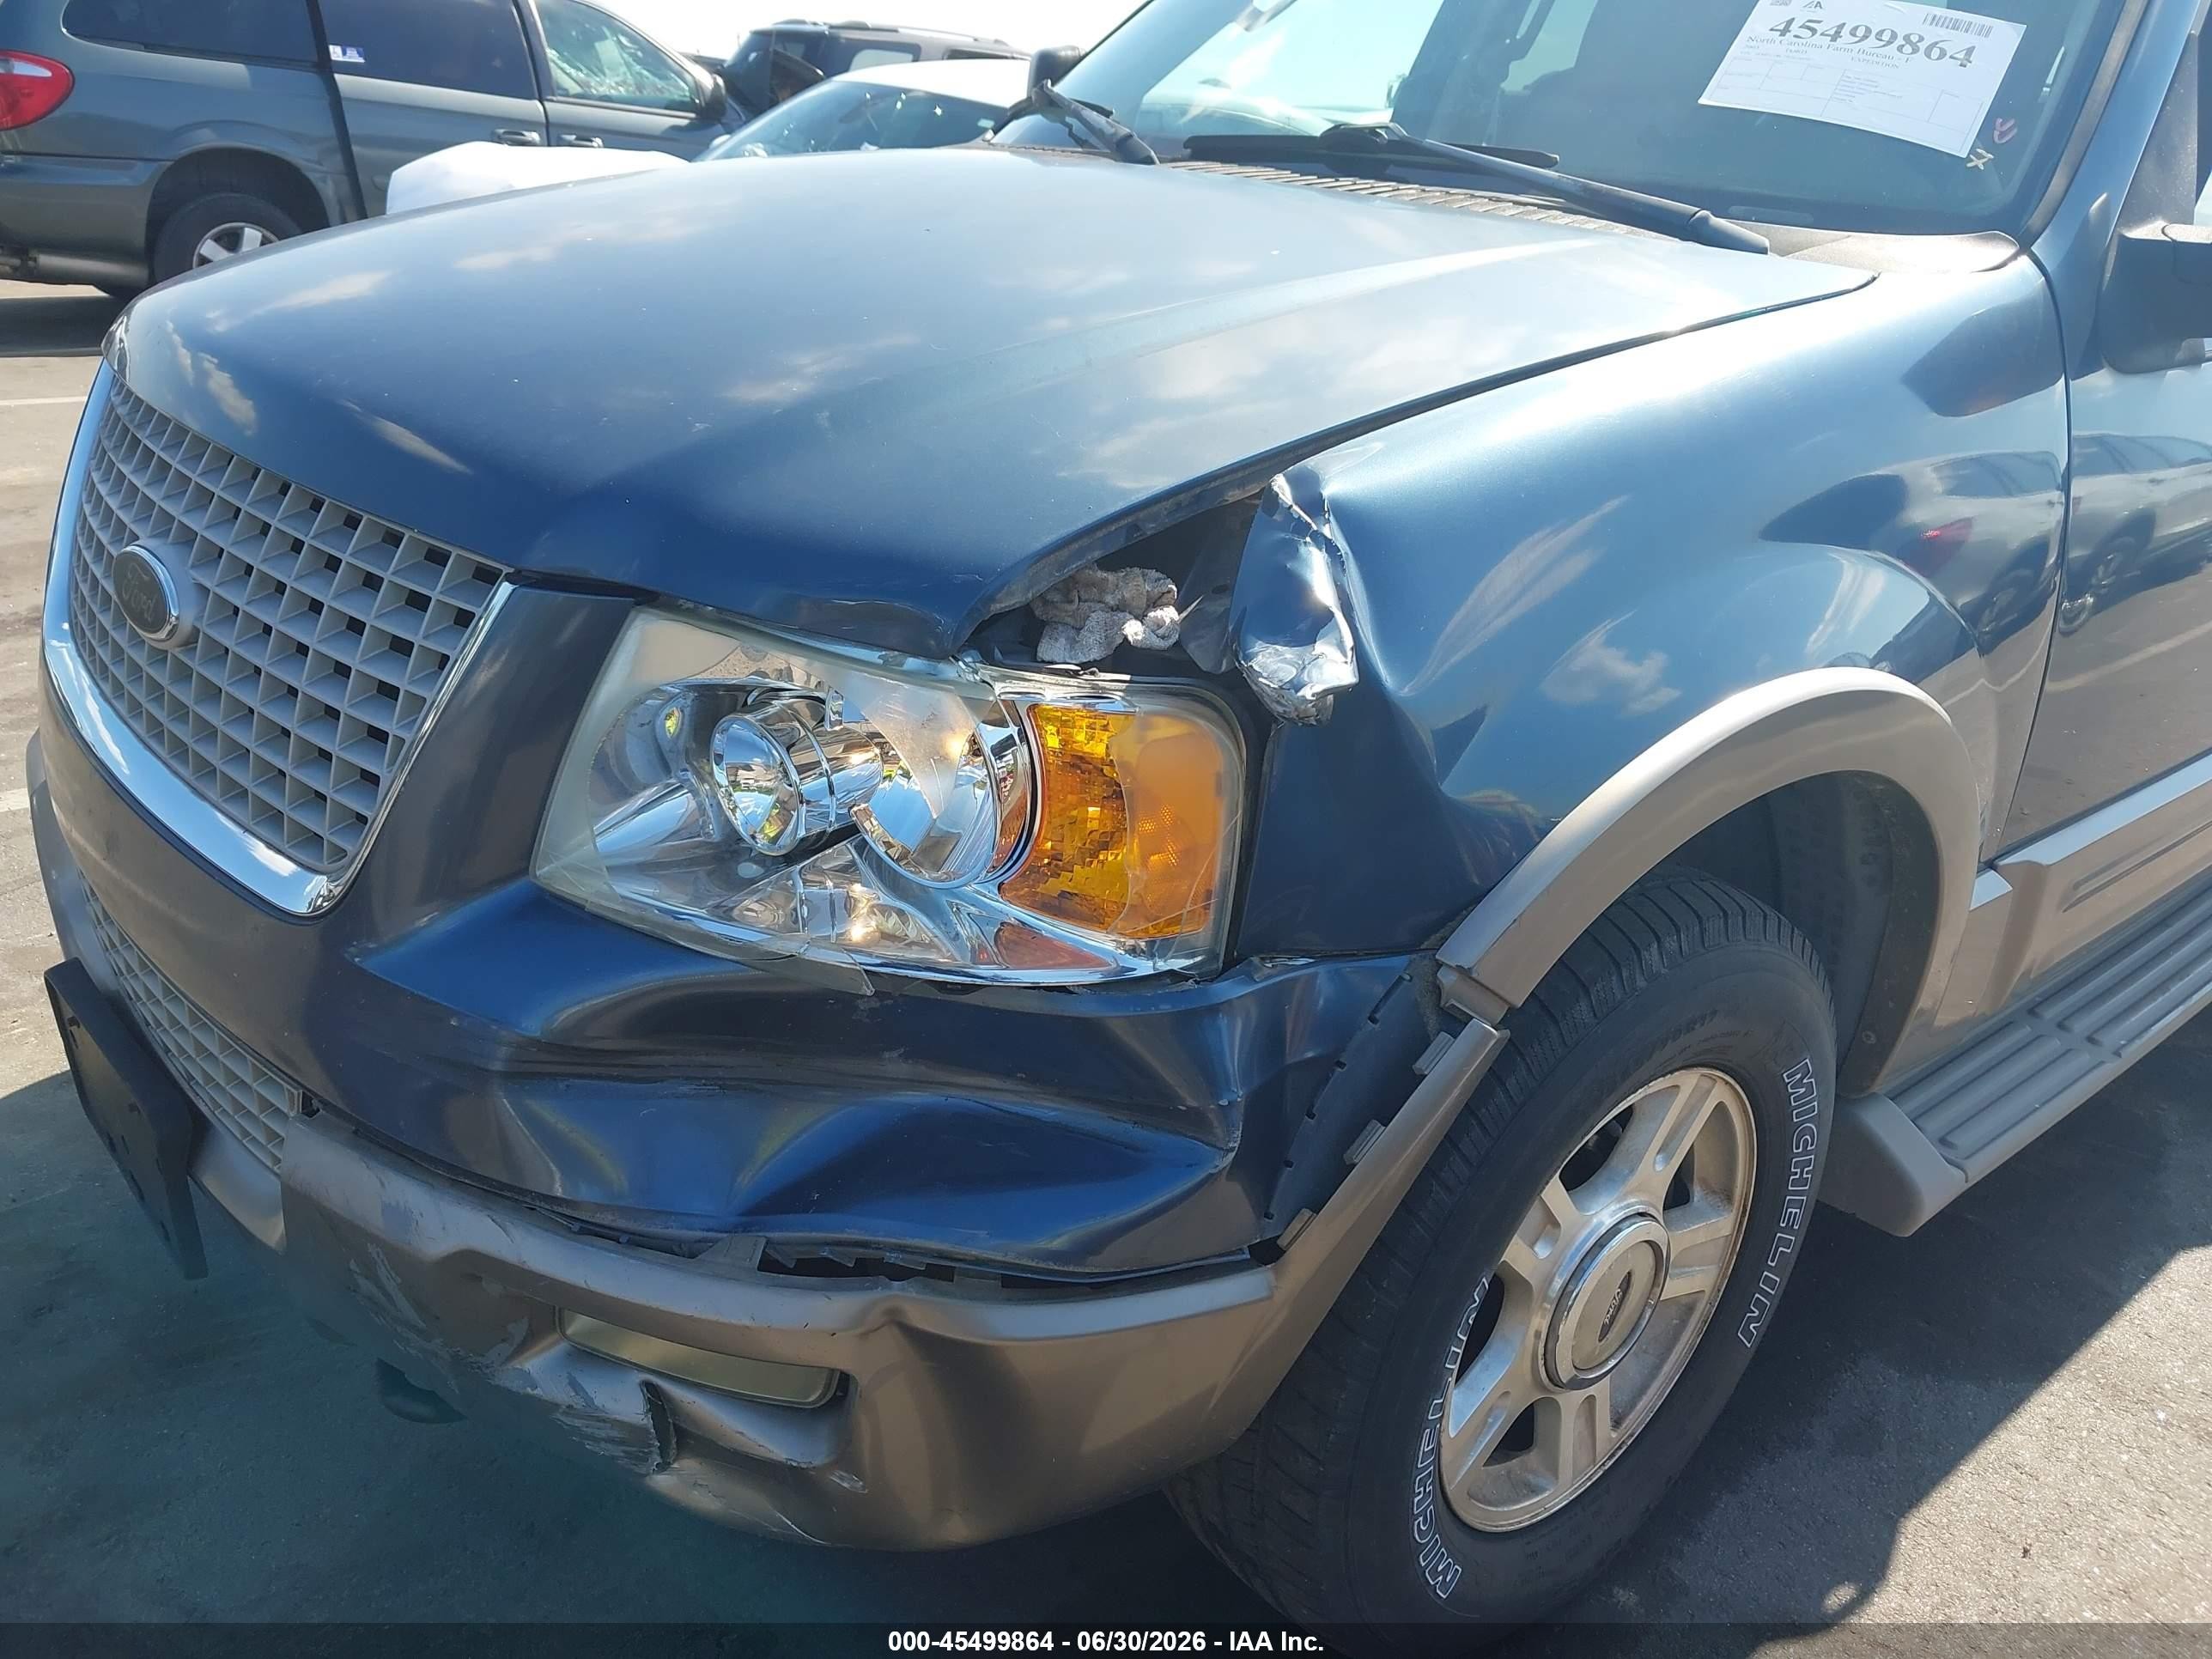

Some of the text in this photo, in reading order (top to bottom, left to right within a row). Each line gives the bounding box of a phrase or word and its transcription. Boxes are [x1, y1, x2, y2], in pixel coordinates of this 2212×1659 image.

[1746, 35, 1777, 46] North
[1778, 38, 1823, 49] Carolina
[1826, 43, 1854, 53] Farm
[1856, 47, 1894, 60] Bureau
[1768, 16, 1978, 69] 45499864
[1736, 1058, 1818, 1348] MICHELIN
[1603, 1287, 1623, 1325] Ford
